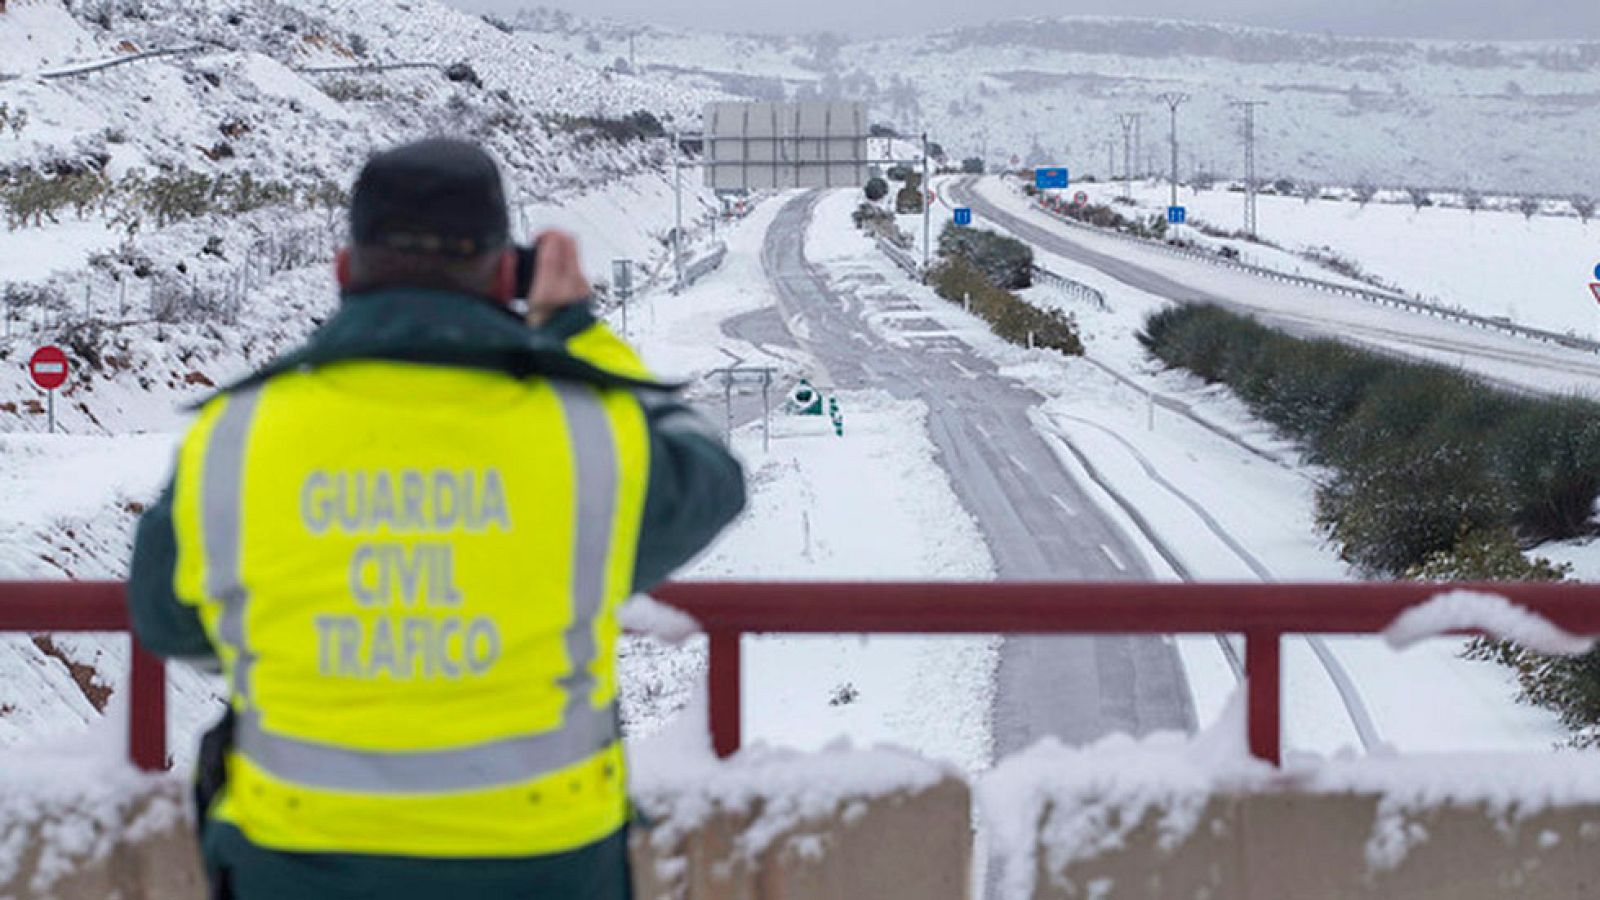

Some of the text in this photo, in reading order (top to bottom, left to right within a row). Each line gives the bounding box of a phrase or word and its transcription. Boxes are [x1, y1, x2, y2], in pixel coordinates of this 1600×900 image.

[301, 468, 511, 534] GUARDIA
[349, 544, 462, 607] CIVIL
[316, 616, 500, 680] TRAFICO
